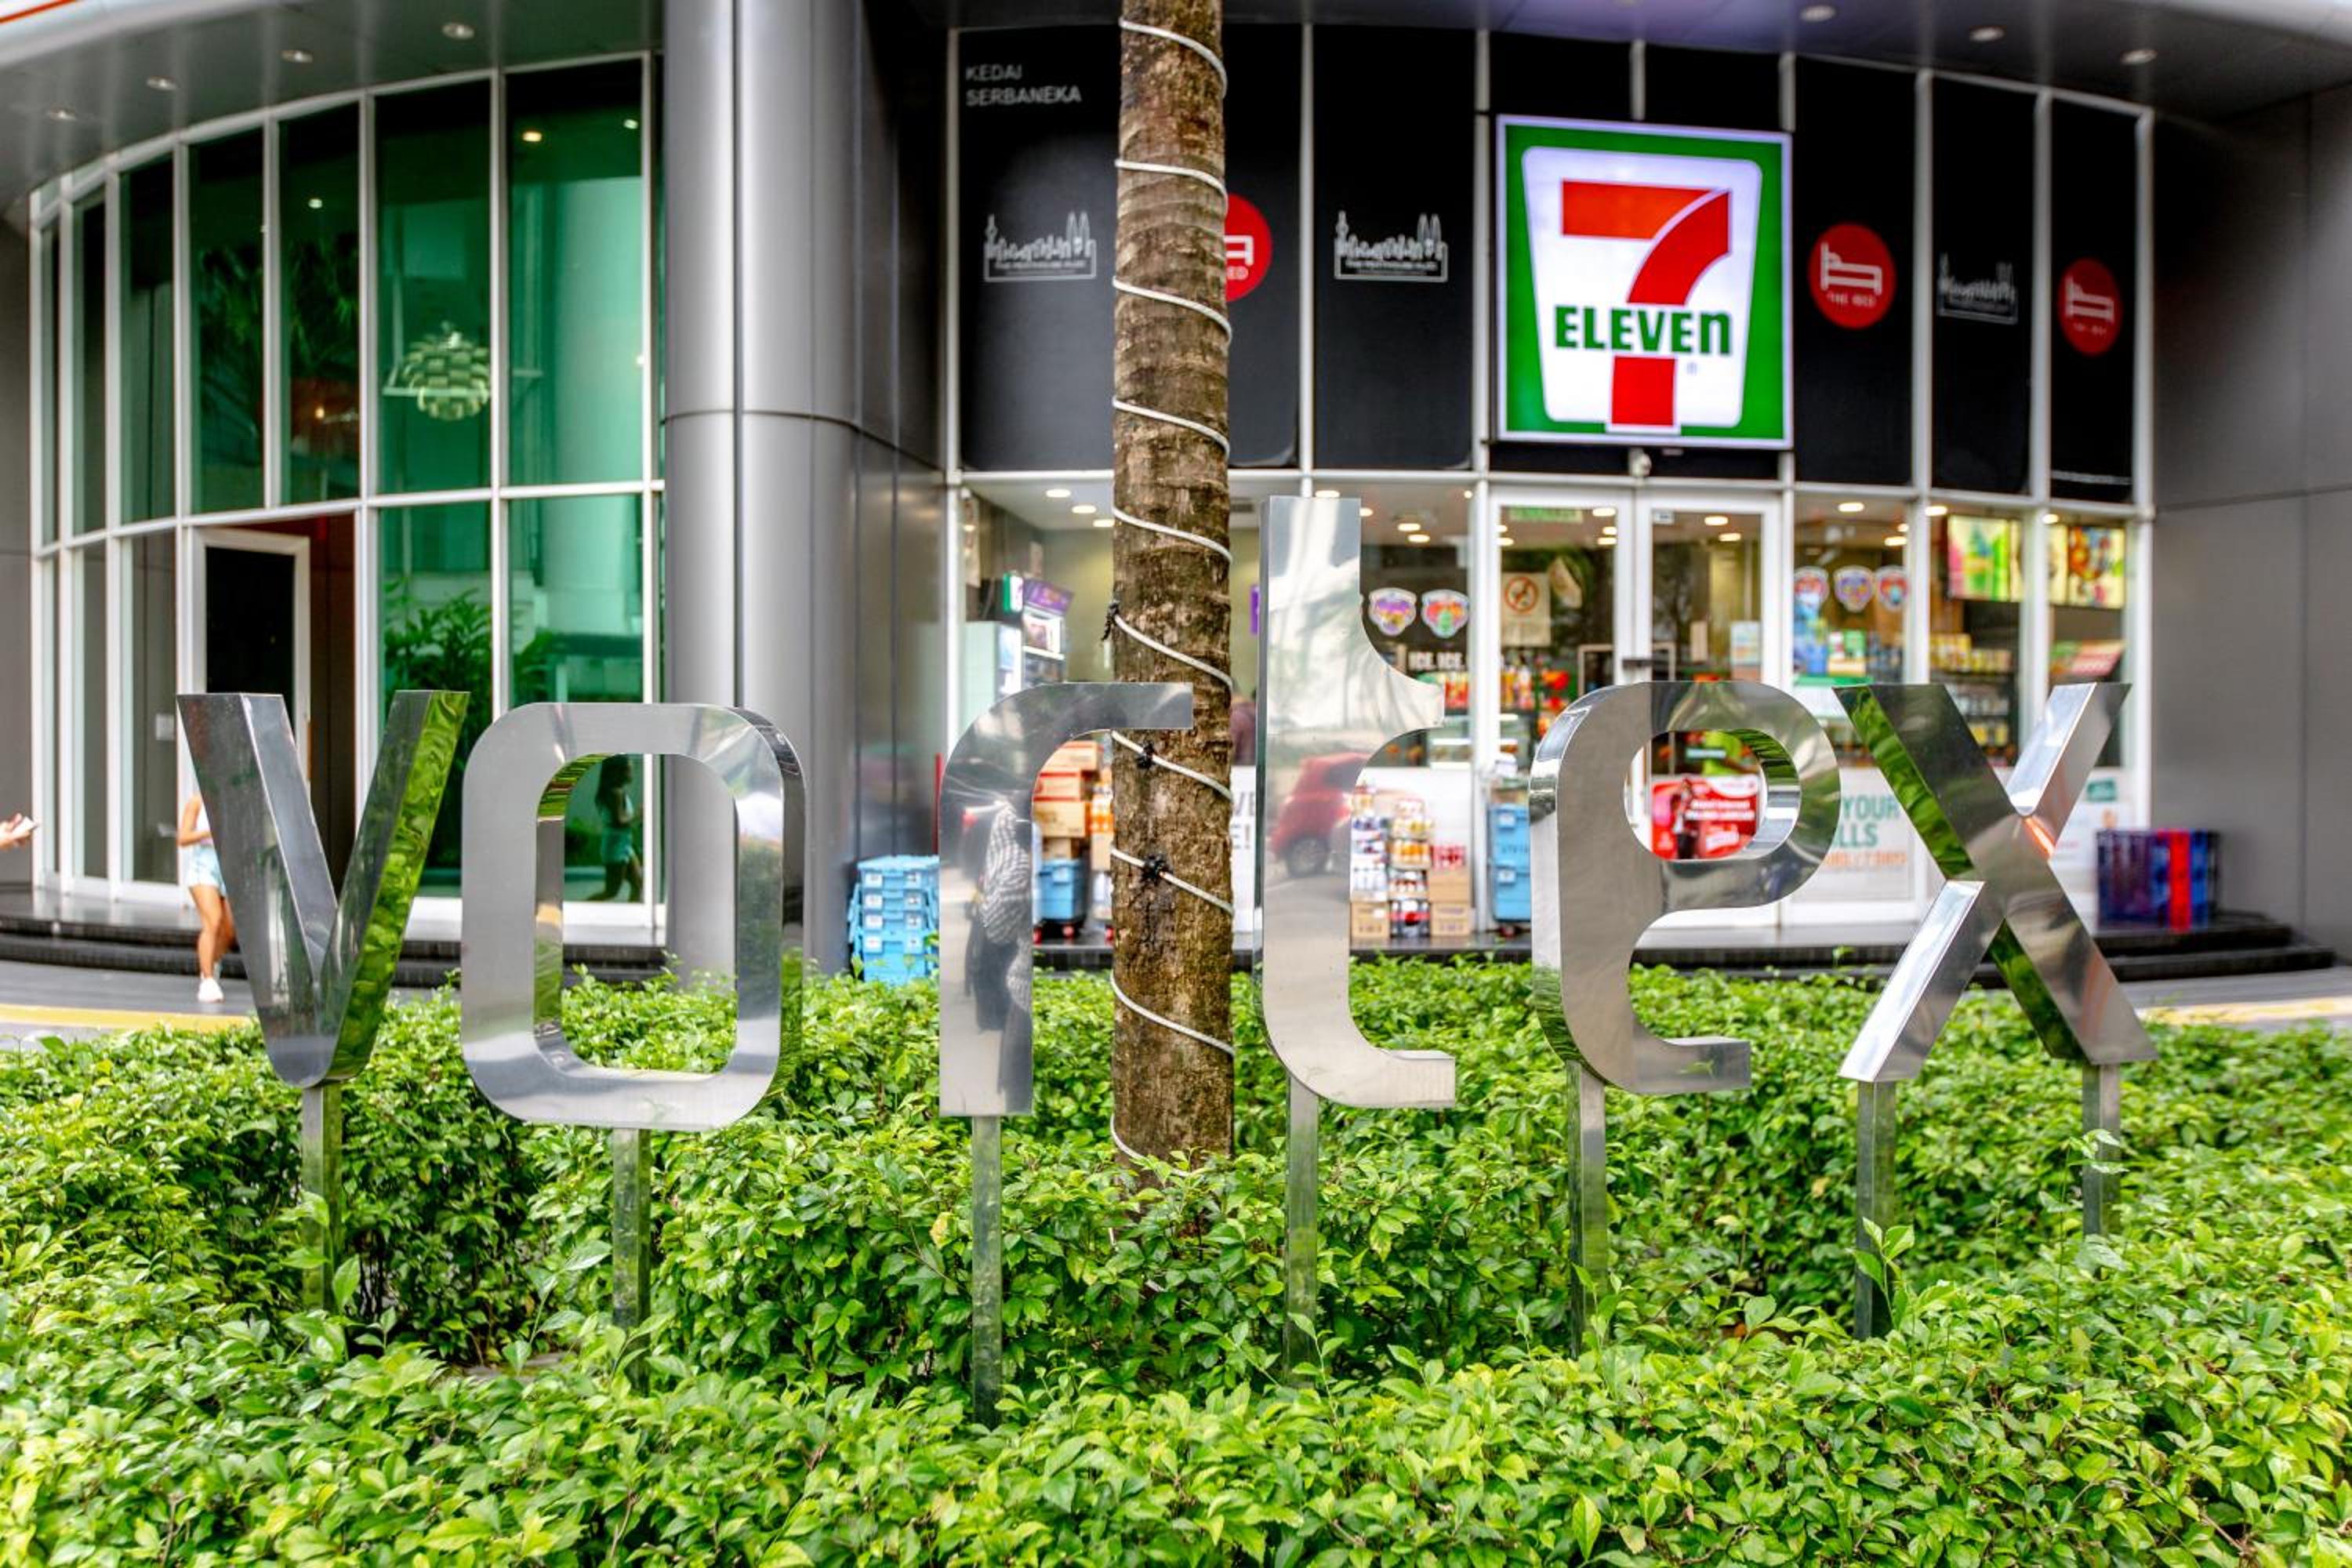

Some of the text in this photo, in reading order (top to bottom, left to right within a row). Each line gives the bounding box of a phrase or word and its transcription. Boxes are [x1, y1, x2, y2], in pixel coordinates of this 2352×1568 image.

[965, 63, 1022, 81] KEDAI
[965, 85, 1082, 107] SERBANEKA
[1226, 265, 1249, 281] ED
[1562, 180, 1731, 426] 7
[176, 496, 2158, 1131] vortex
[1842, 794, 1901, 821] YOUR
[1835, 822, 1878, 848] LLS
